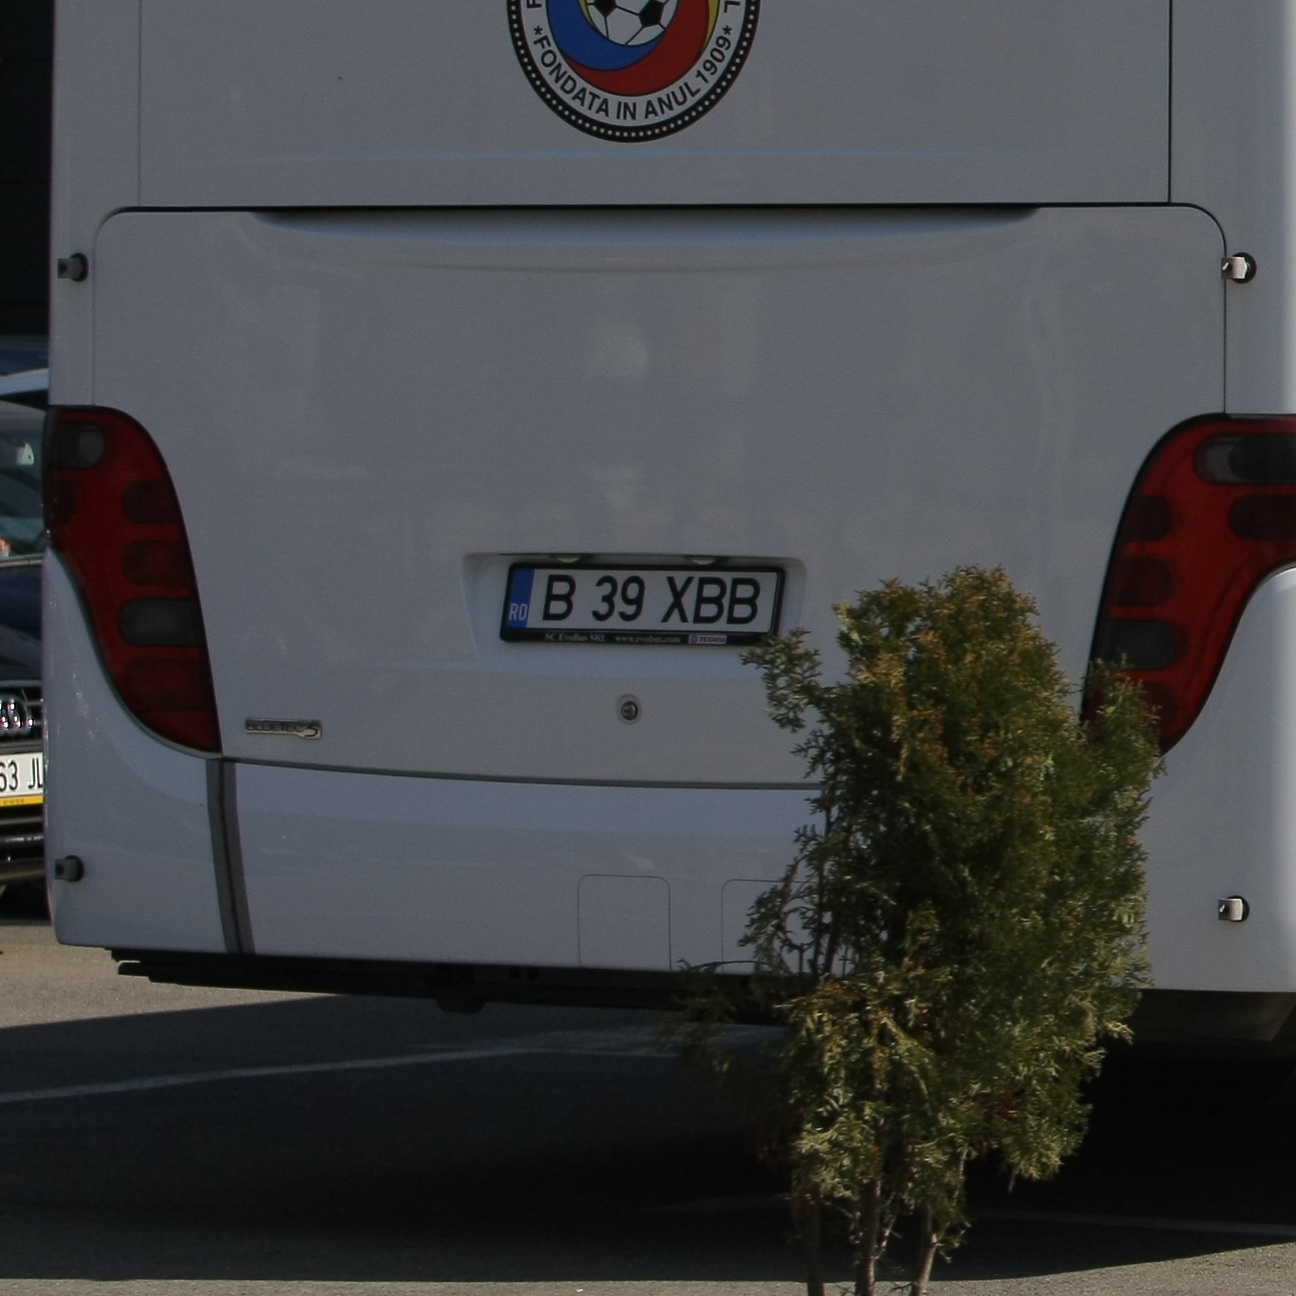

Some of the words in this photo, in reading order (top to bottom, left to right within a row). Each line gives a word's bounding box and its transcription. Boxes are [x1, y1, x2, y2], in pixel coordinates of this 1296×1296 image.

[533, 35, 610, 118] FONDATA
[616, 101, 637, 120] IN
[644, 81, 702, 119] ANUL
[695, 34, 732, 84] 1909
[508, 603, 528, 622] RO
[542, 574, 577, 622] B
[591, 575, 646, 623] 39
[660, 575, 761, 625] XBB
